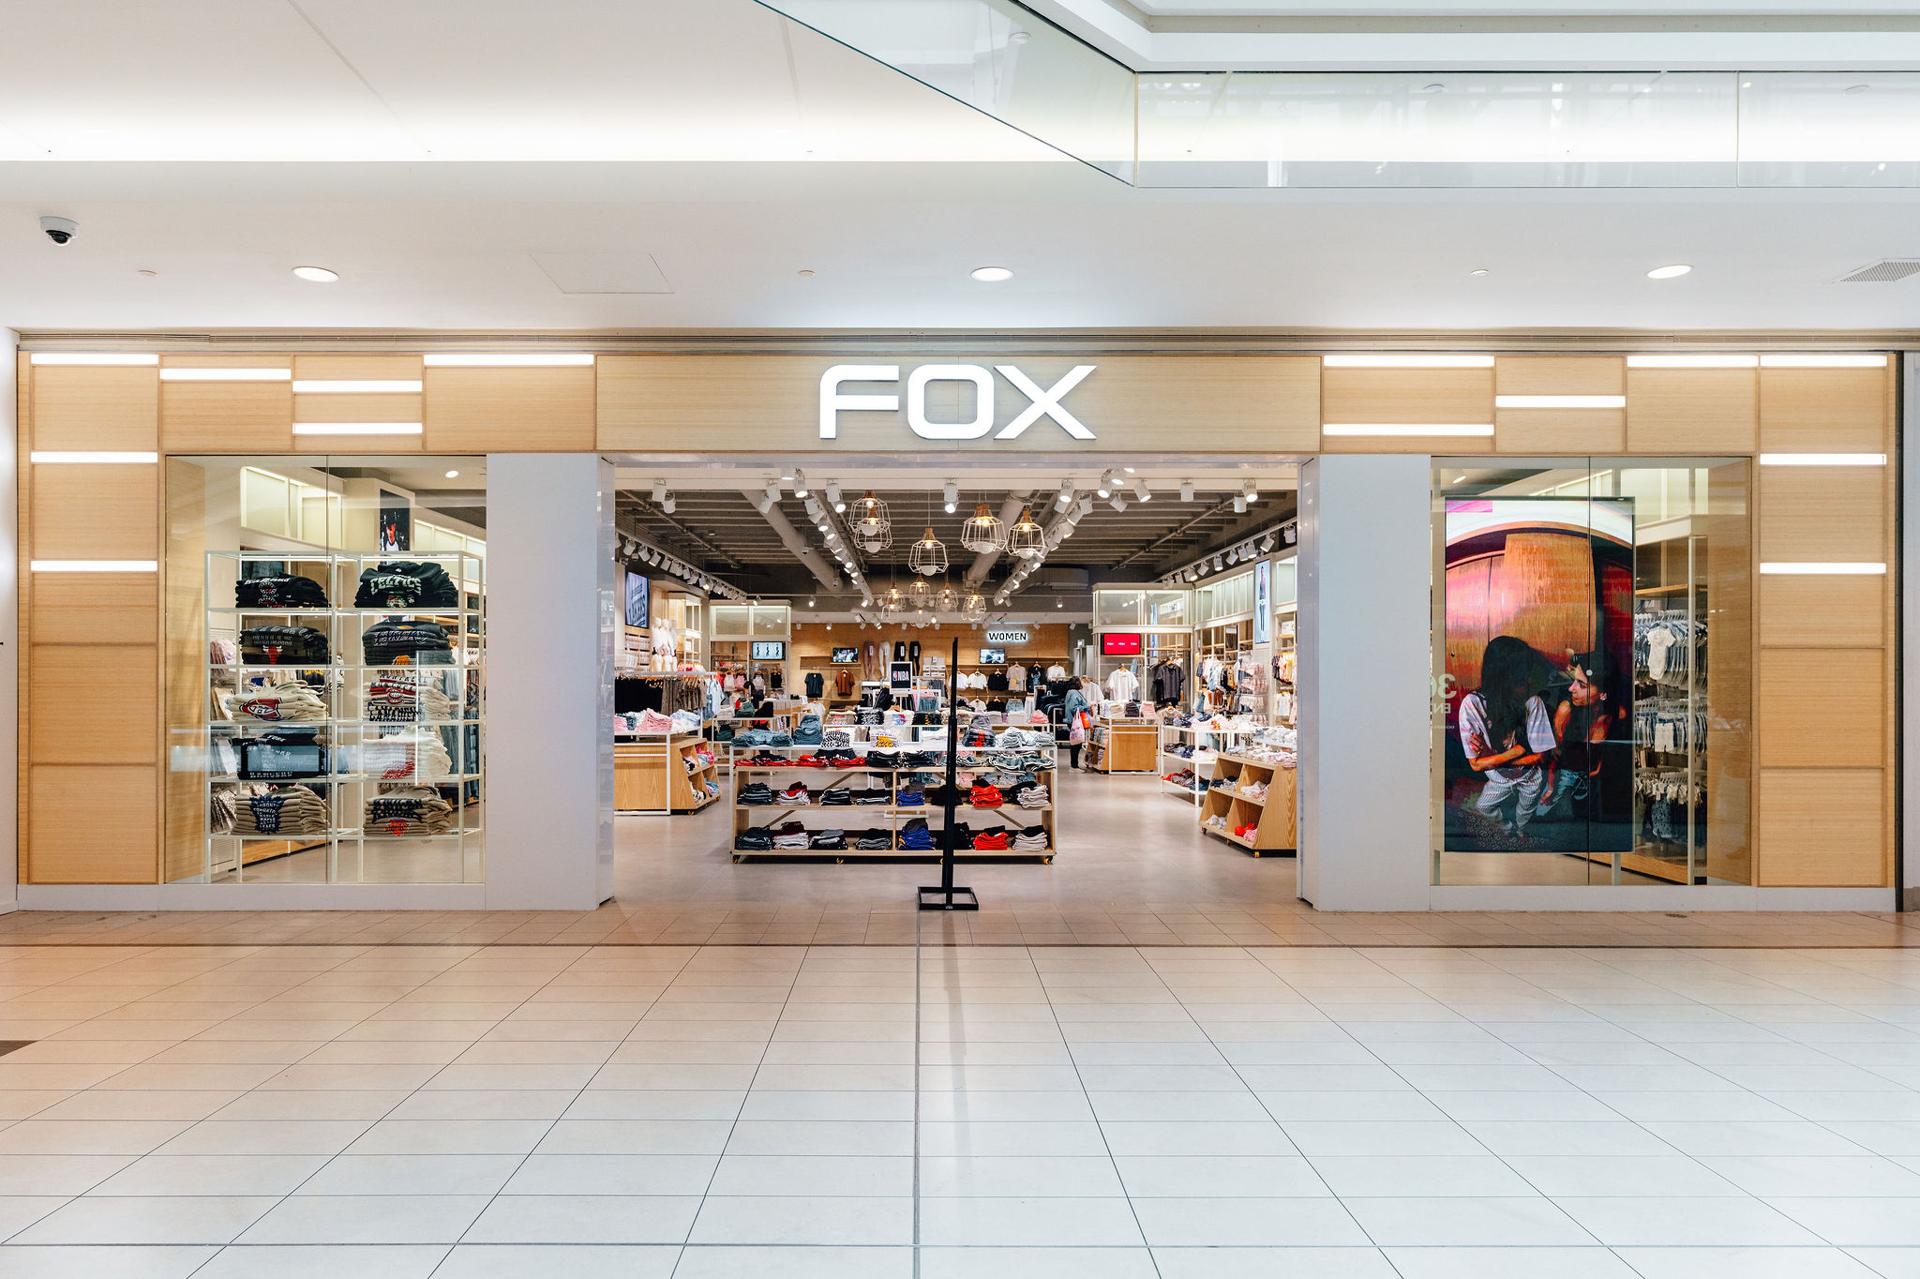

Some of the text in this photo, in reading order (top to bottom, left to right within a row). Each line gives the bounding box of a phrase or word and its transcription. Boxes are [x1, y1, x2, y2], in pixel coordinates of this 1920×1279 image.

[819, 364, 1097, 440] FOX
[370, 575, 422, 595] CELTICS
[988, 632, 1028, 641] WOMEN
[897, 671, 910, 681] NBA
